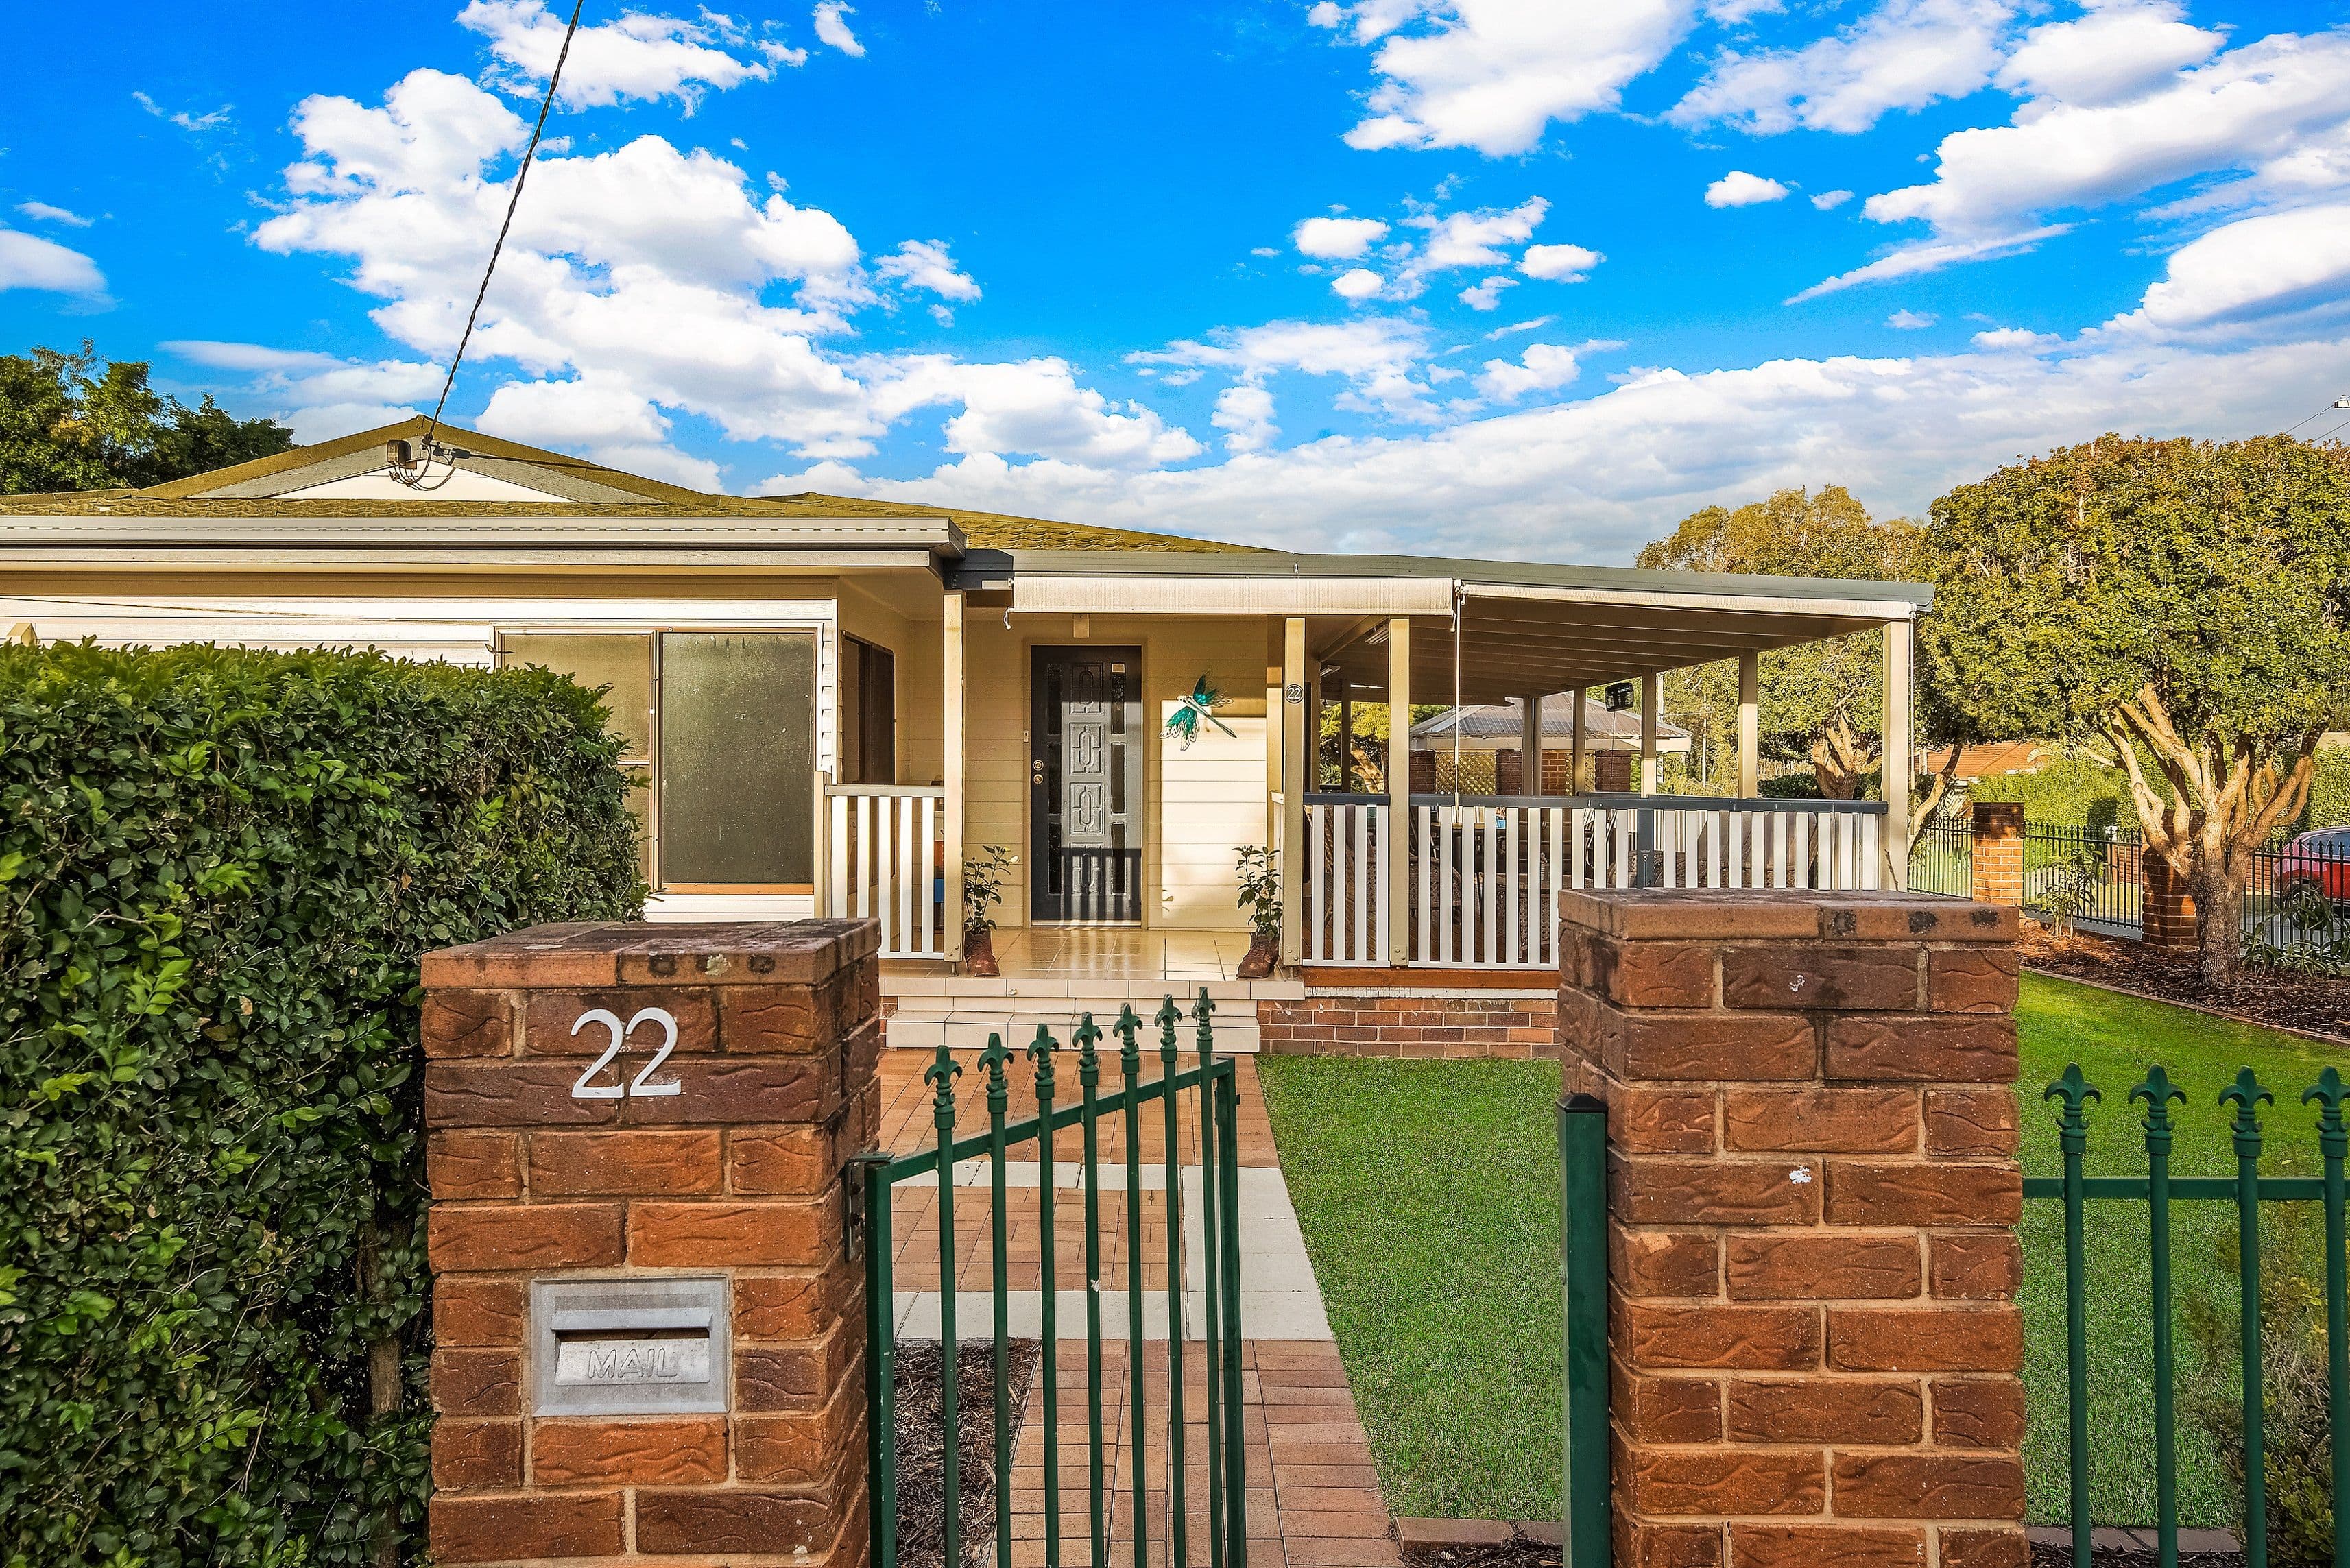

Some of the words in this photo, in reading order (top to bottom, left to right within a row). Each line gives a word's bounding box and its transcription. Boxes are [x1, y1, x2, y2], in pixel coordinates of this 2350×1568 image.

[1288, 688, 1301, 699] 22
[571, 1008, 682, 1098] 22
[588, 1347, 678, 1378] MAIL
